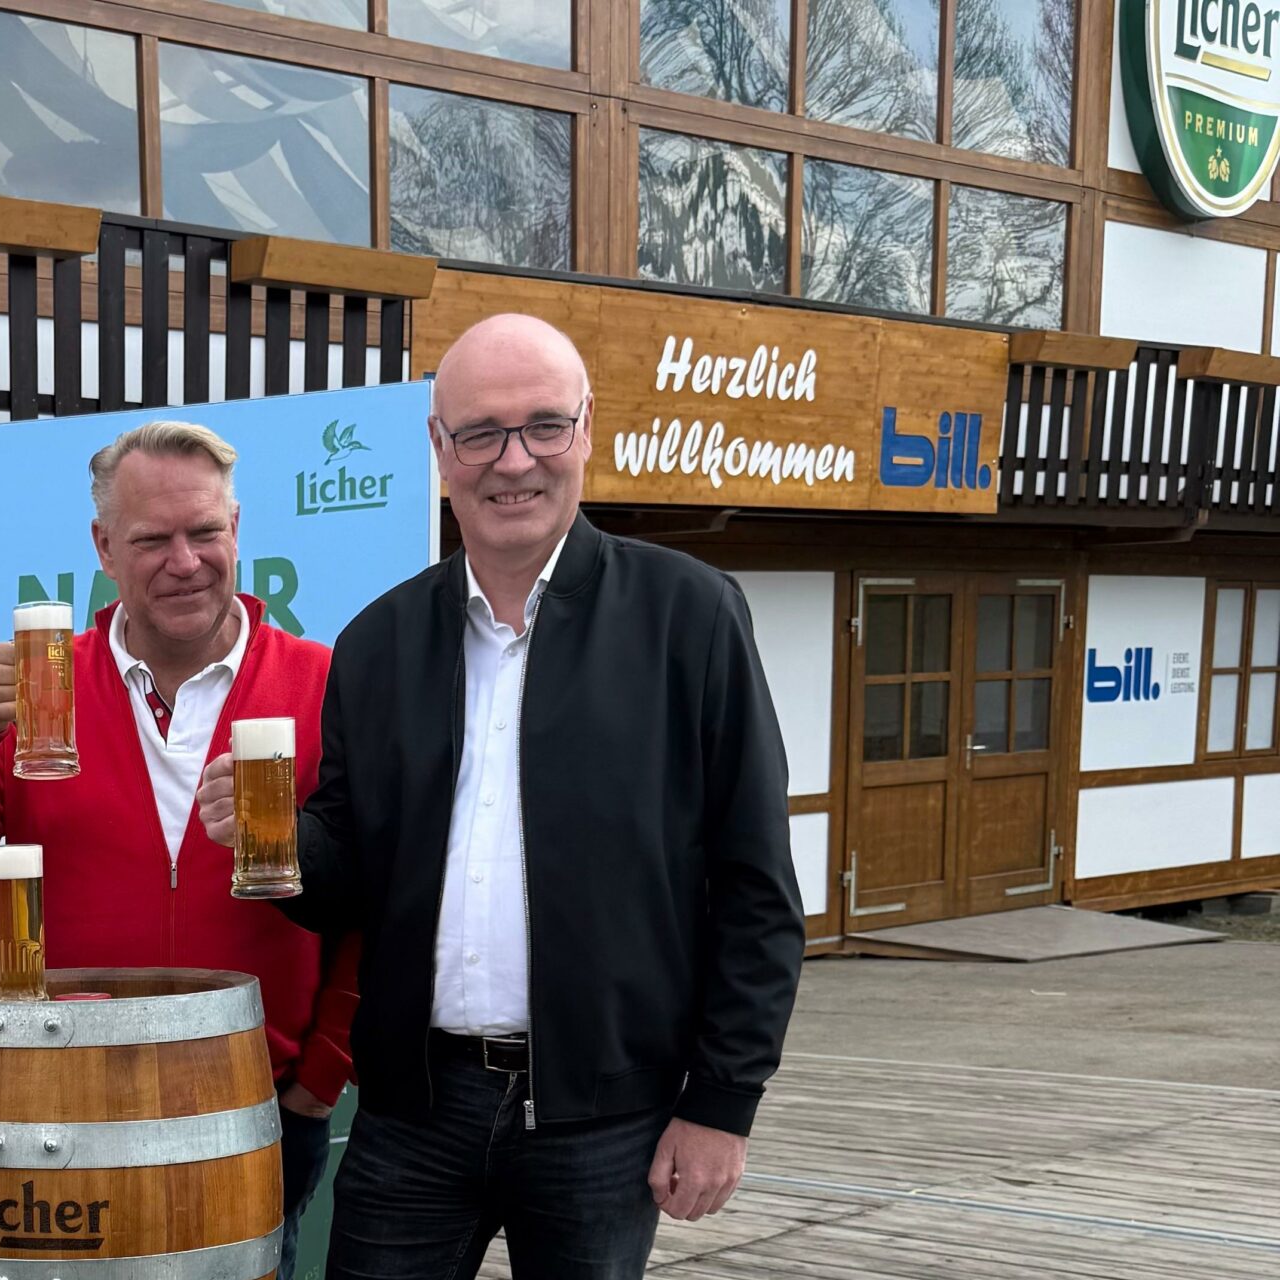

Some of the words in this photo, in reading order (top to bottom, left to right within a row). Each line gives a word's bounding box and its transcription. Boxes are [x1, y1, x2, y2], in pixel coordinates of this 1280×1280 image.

[1185, 111, 1258, 147] PREMIUM
[656, 335, 817, 401] Herzlich
[614, 418, 855, 489] willkommen
[879, 406, 992, 490] bill.
[296, 465, 393, 516] Licher
[1086, 647, 1160, 703] bill.
